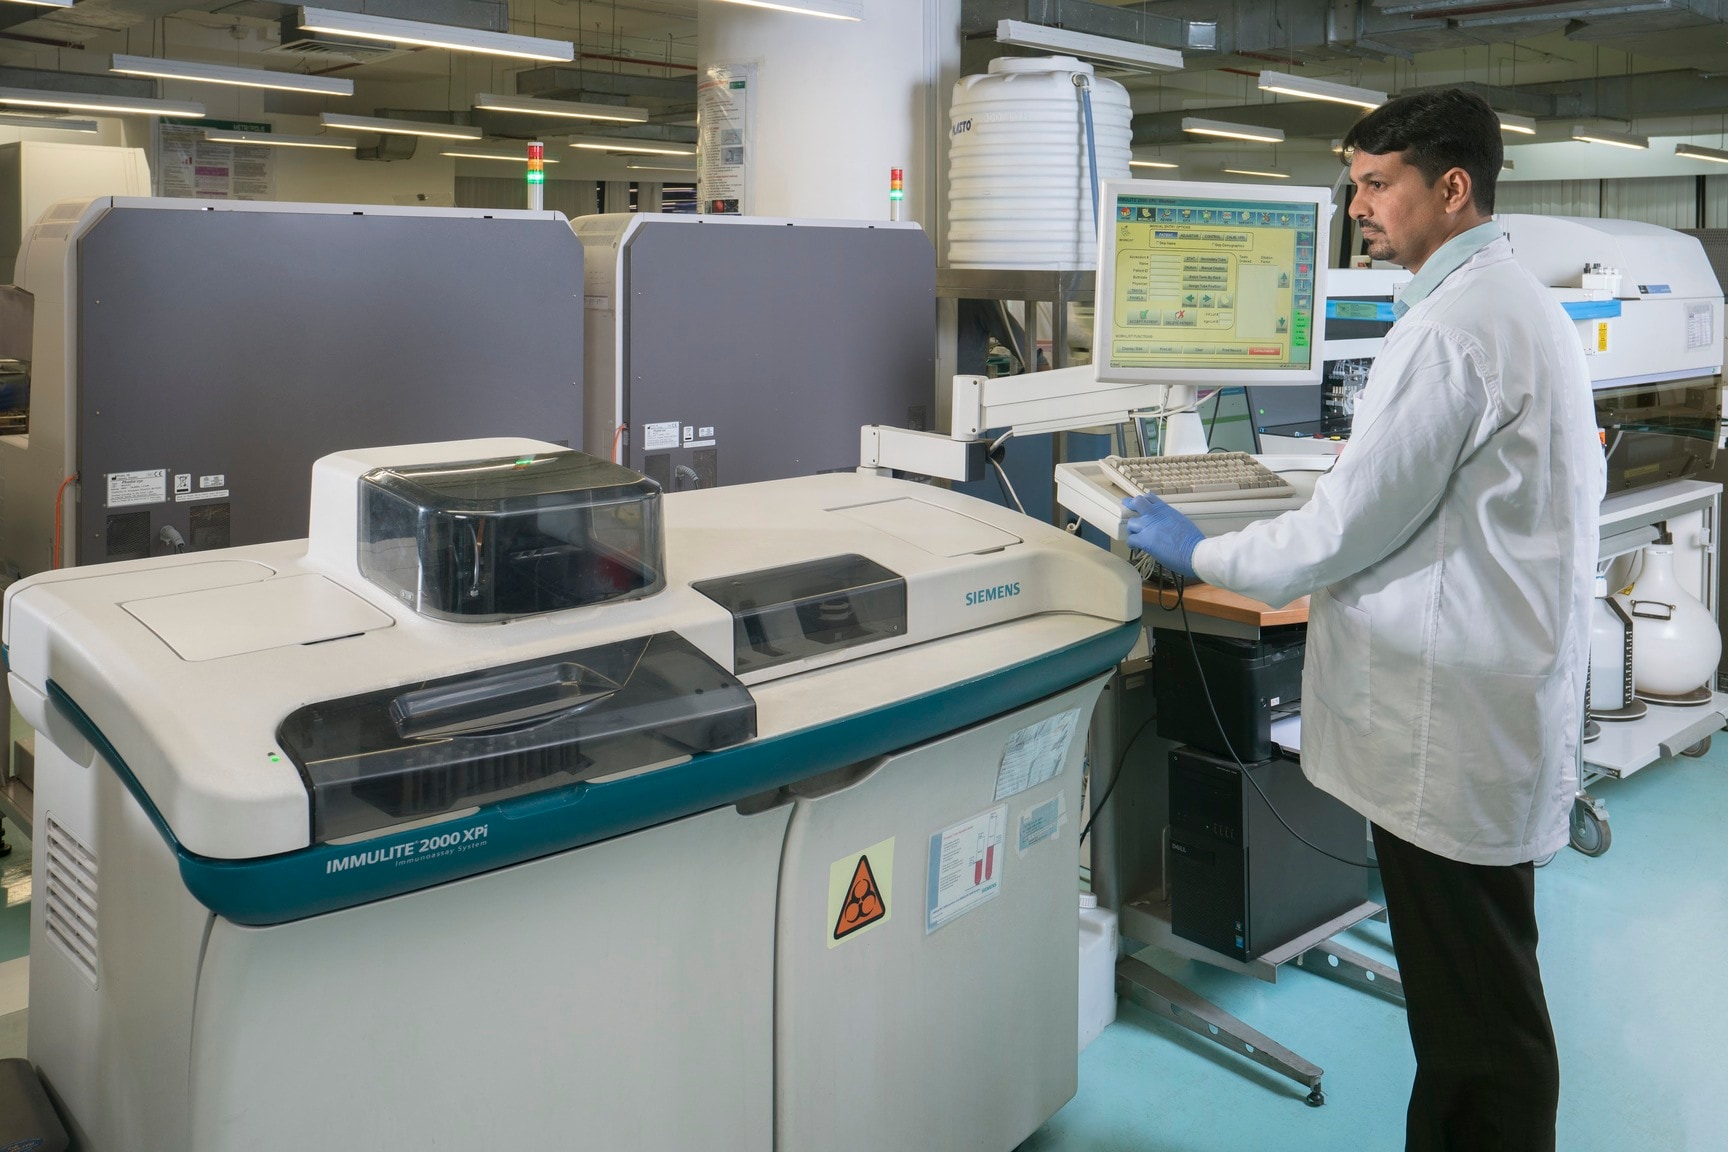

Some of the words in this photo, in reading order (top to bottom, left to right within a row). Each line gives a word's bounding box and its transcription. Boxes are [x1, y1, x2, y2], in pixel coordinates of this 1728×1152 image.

[965, 582, 1020, 606] SIEMENS
[326, 842, 415, 874] IMMULITE
[418, 831, 461, 853] 2000
[462, 824, 489, 842] XPi
[395, 848, 454, 867] Immunoassay
[457, 839, 487, 852] System
[1172, 843, 1187, 853] DELL
